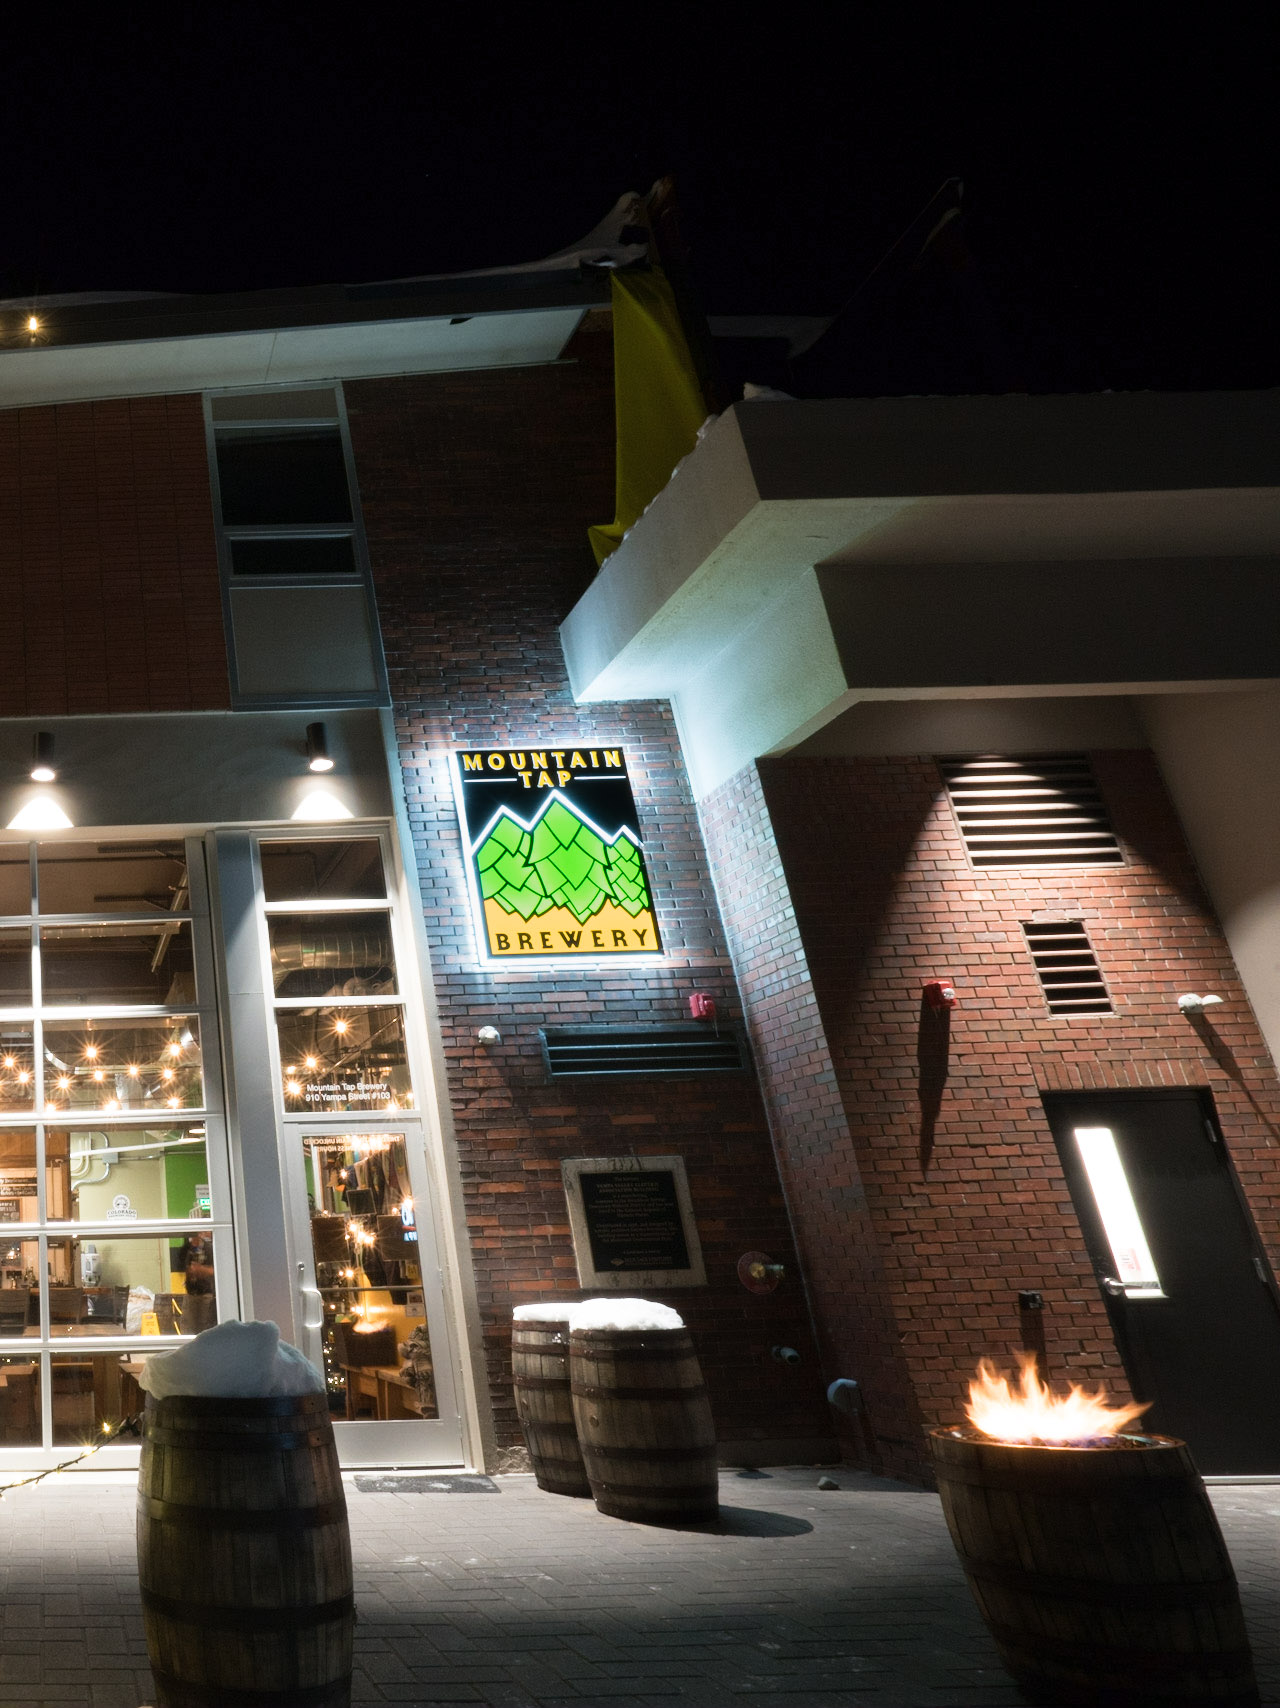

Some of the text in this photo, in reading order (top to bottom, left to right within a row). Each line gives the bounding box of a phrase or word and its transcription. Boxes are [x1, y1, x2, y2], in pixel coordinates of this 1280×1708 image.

[462, 750, 621, 771] MOUNTAIN
[518, 770, 572, 788] TAP
[496, 929, 647, 950] BREWERY
[342, 1083, 355, 1091] Tap
[348, 1092, 370, 1100] Street
